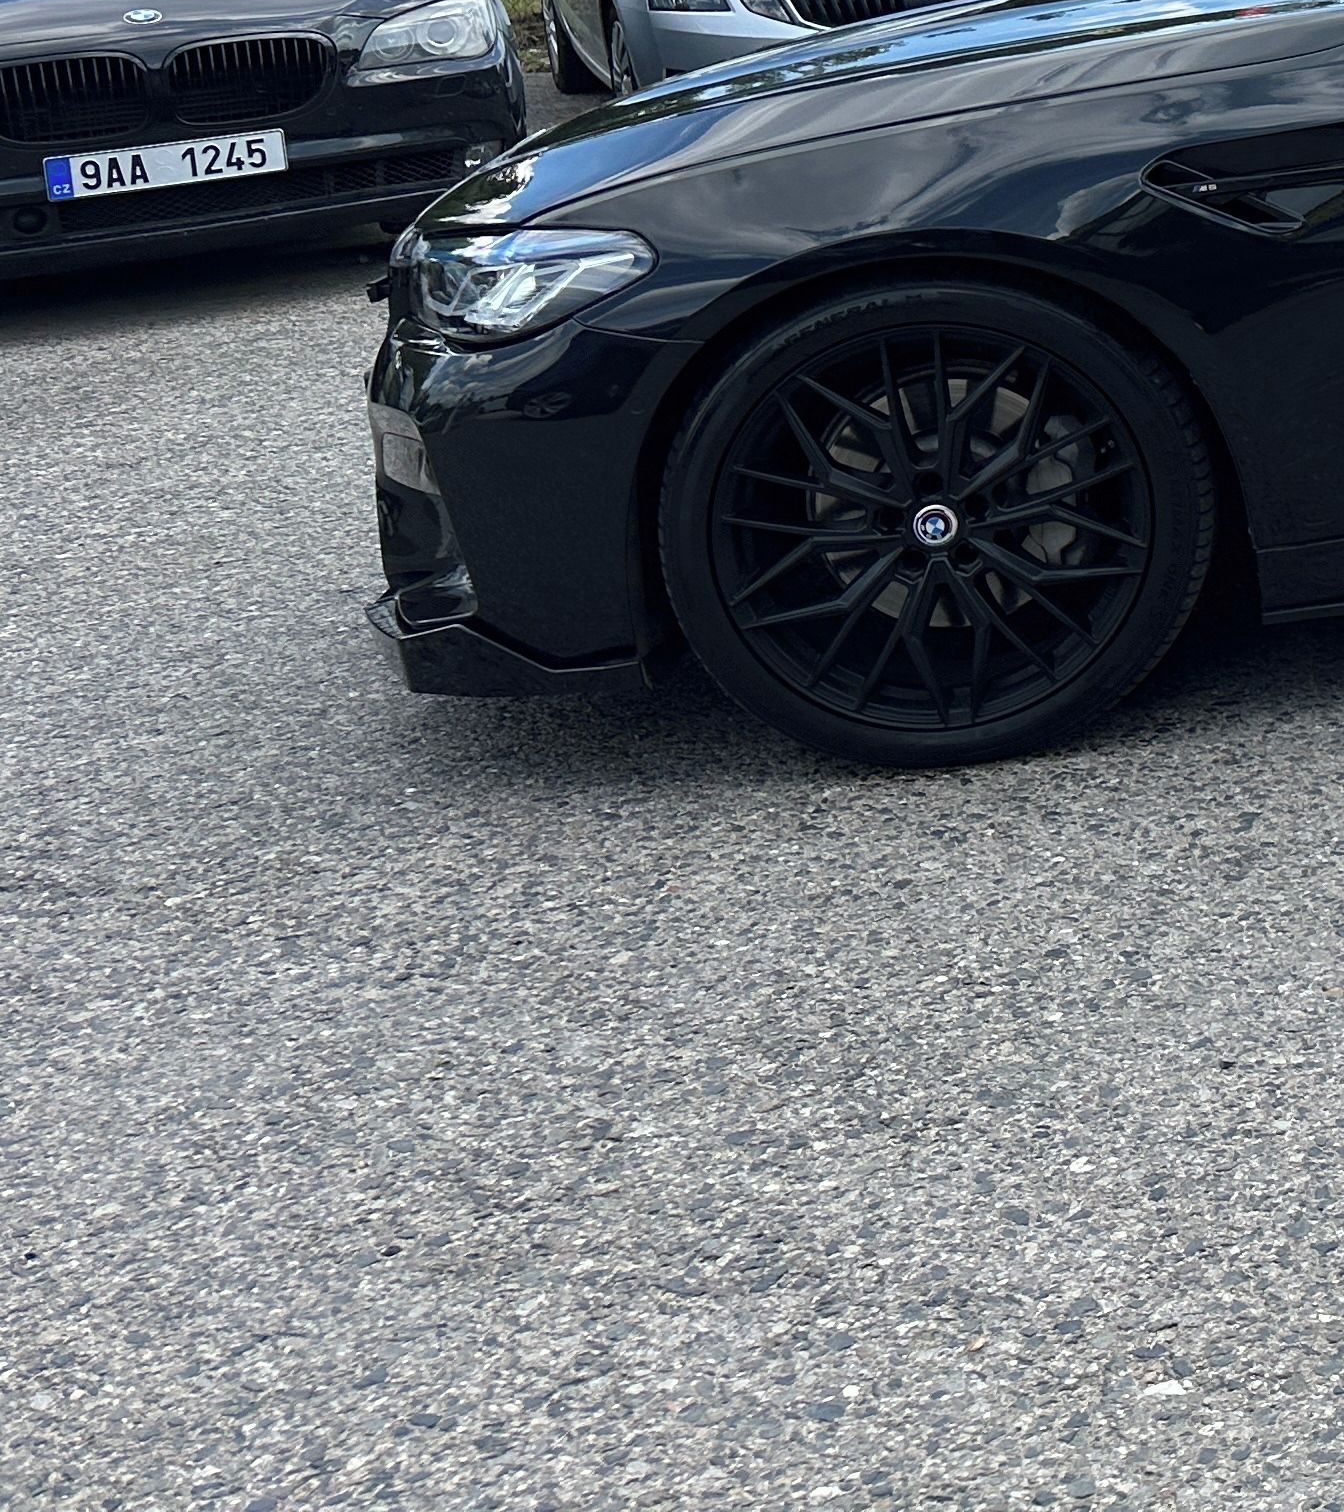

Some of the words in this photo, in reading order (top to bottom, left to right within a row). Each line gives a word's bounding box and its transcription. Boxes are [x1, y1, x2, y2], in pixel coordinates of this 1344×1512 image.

[80, 153, 150, 190] 9AA
[181, 138, 267, 177] 1245
[53, 183, 70, 195] CZ
